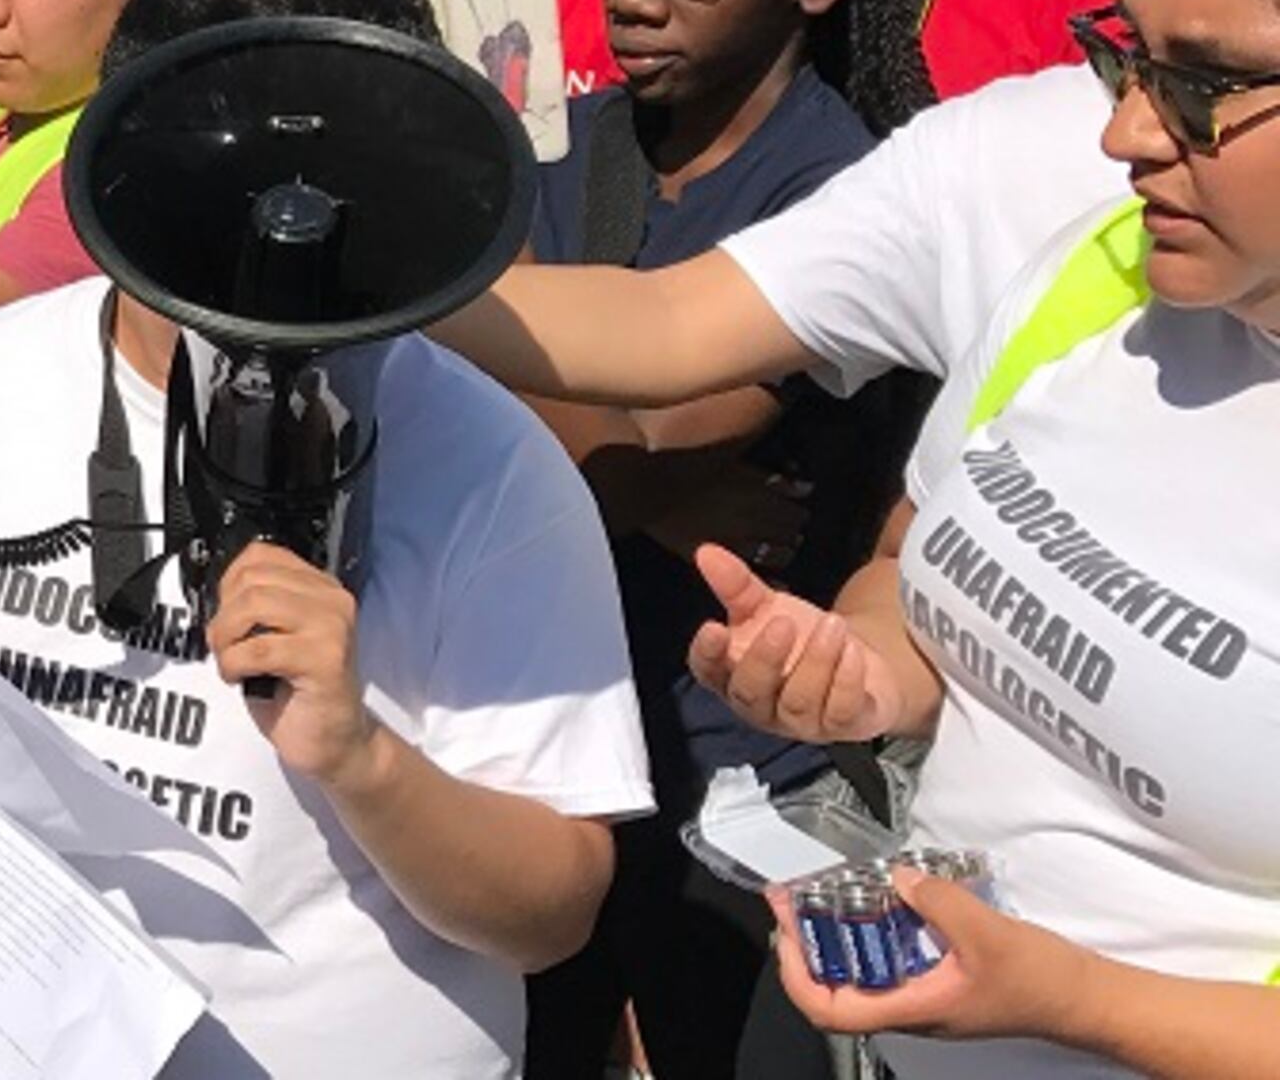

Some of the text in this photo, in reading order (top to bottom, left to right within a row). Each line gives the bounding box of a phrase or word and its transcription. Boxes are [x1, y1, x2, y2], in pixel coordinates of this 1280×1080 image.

[921, 515, 1117, 705] UNAFRAID
[961, 439, 1248, 681] UNDOCUMENTED
[901, 579, 1166, 819] APOLOGETIC
